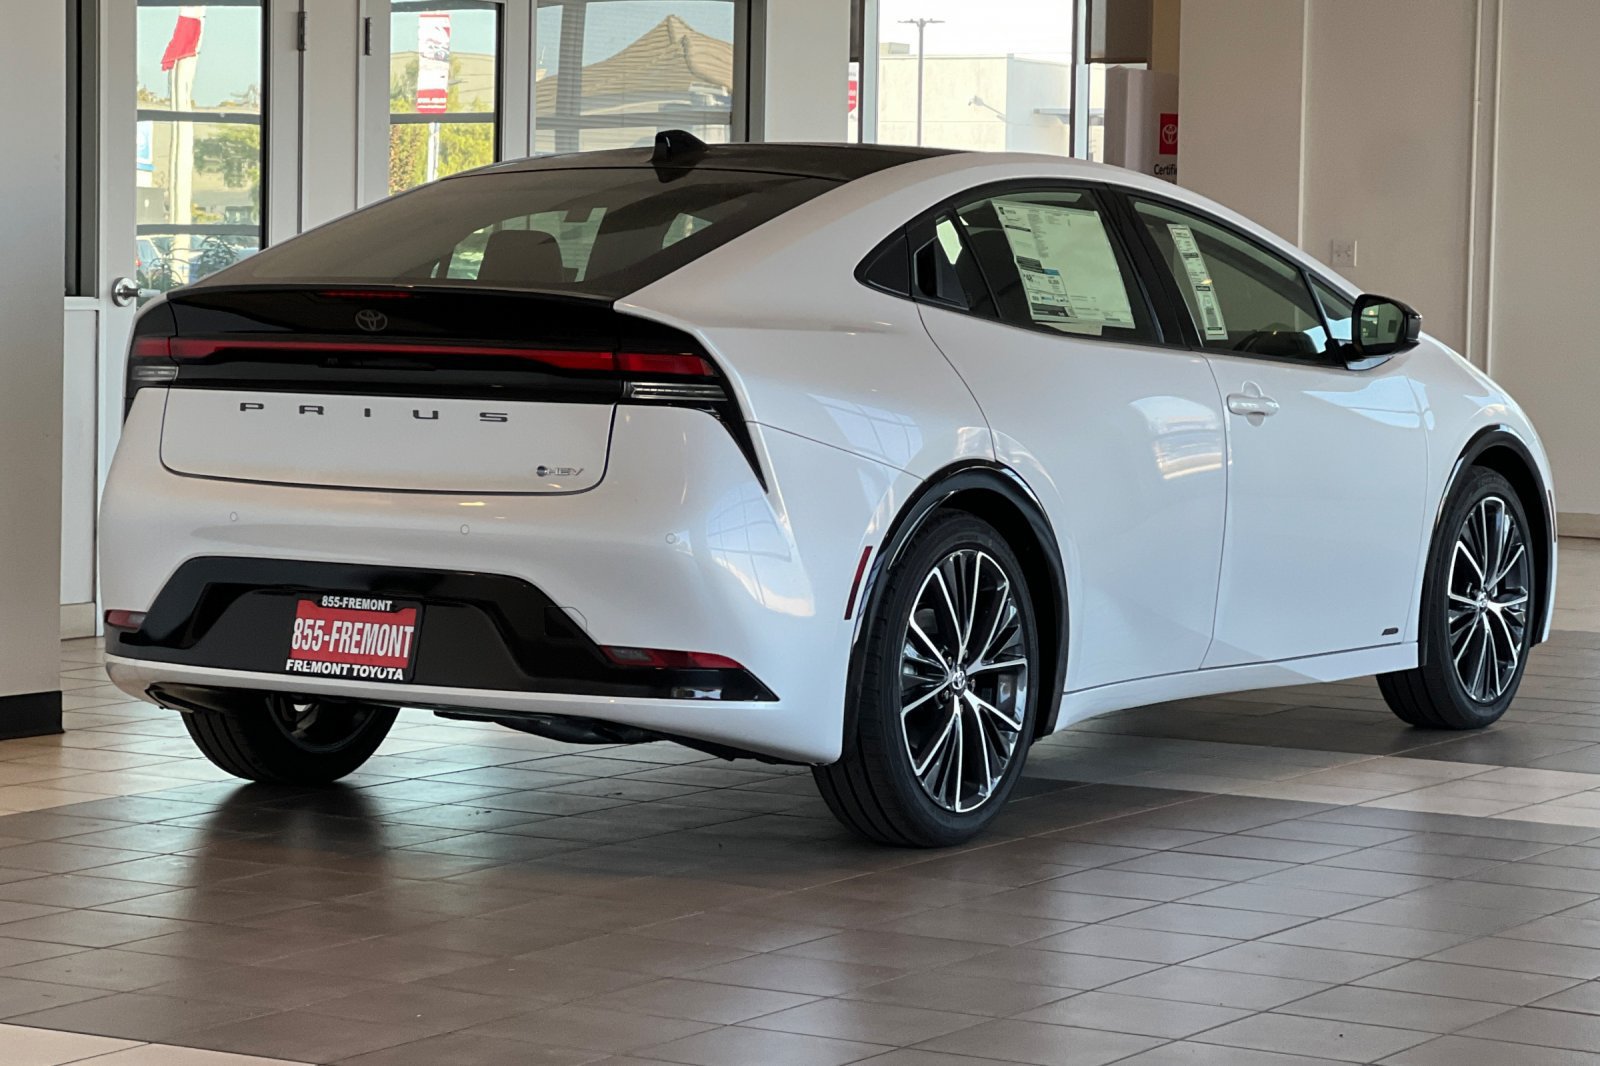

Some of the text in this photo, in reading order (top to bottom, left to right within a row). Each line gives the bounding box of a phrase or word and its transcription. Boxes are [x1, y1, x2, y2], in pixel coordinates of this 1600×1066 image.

[240, 402, 508, 422] PRIUS
[321, 595, 392, 611] 855-FREMONT
[291, 618, 414, 658] 855-FREMONT
[285, 659, 403, 680] FREMONT TOYOTA
